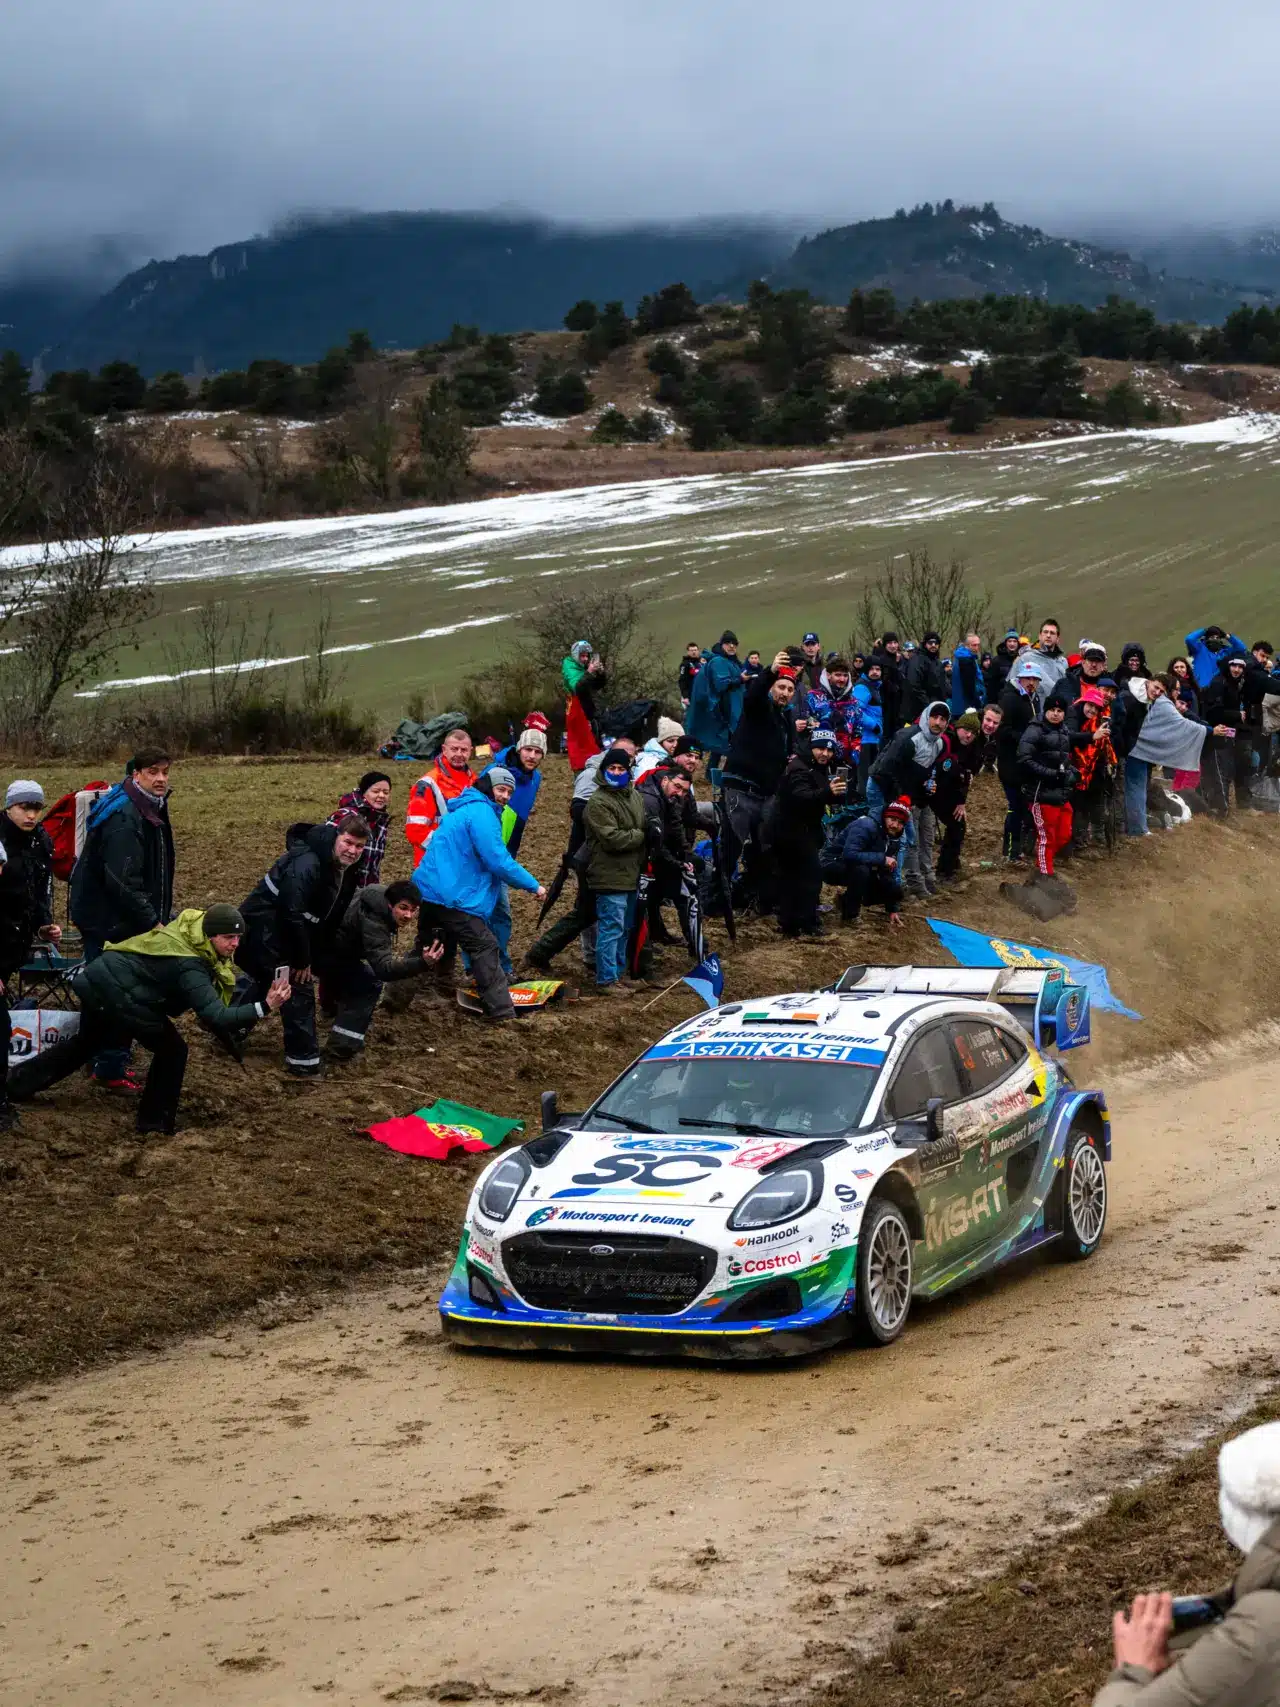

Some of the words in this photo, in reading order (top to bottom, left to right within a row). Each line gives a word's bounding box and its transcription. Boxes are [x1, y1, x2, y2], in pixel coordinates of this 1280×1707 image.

[710, 1030, 808, 1040] Motorsport
[810, 1032, 879, 1045] Ireland
[571, 1153, 722, 1187] SC
[558, 1211, 640, 1224] Motorsport
[640, 1213, 695, 1227] Ireland
[744, 1251, 802, 1273] Castrol
